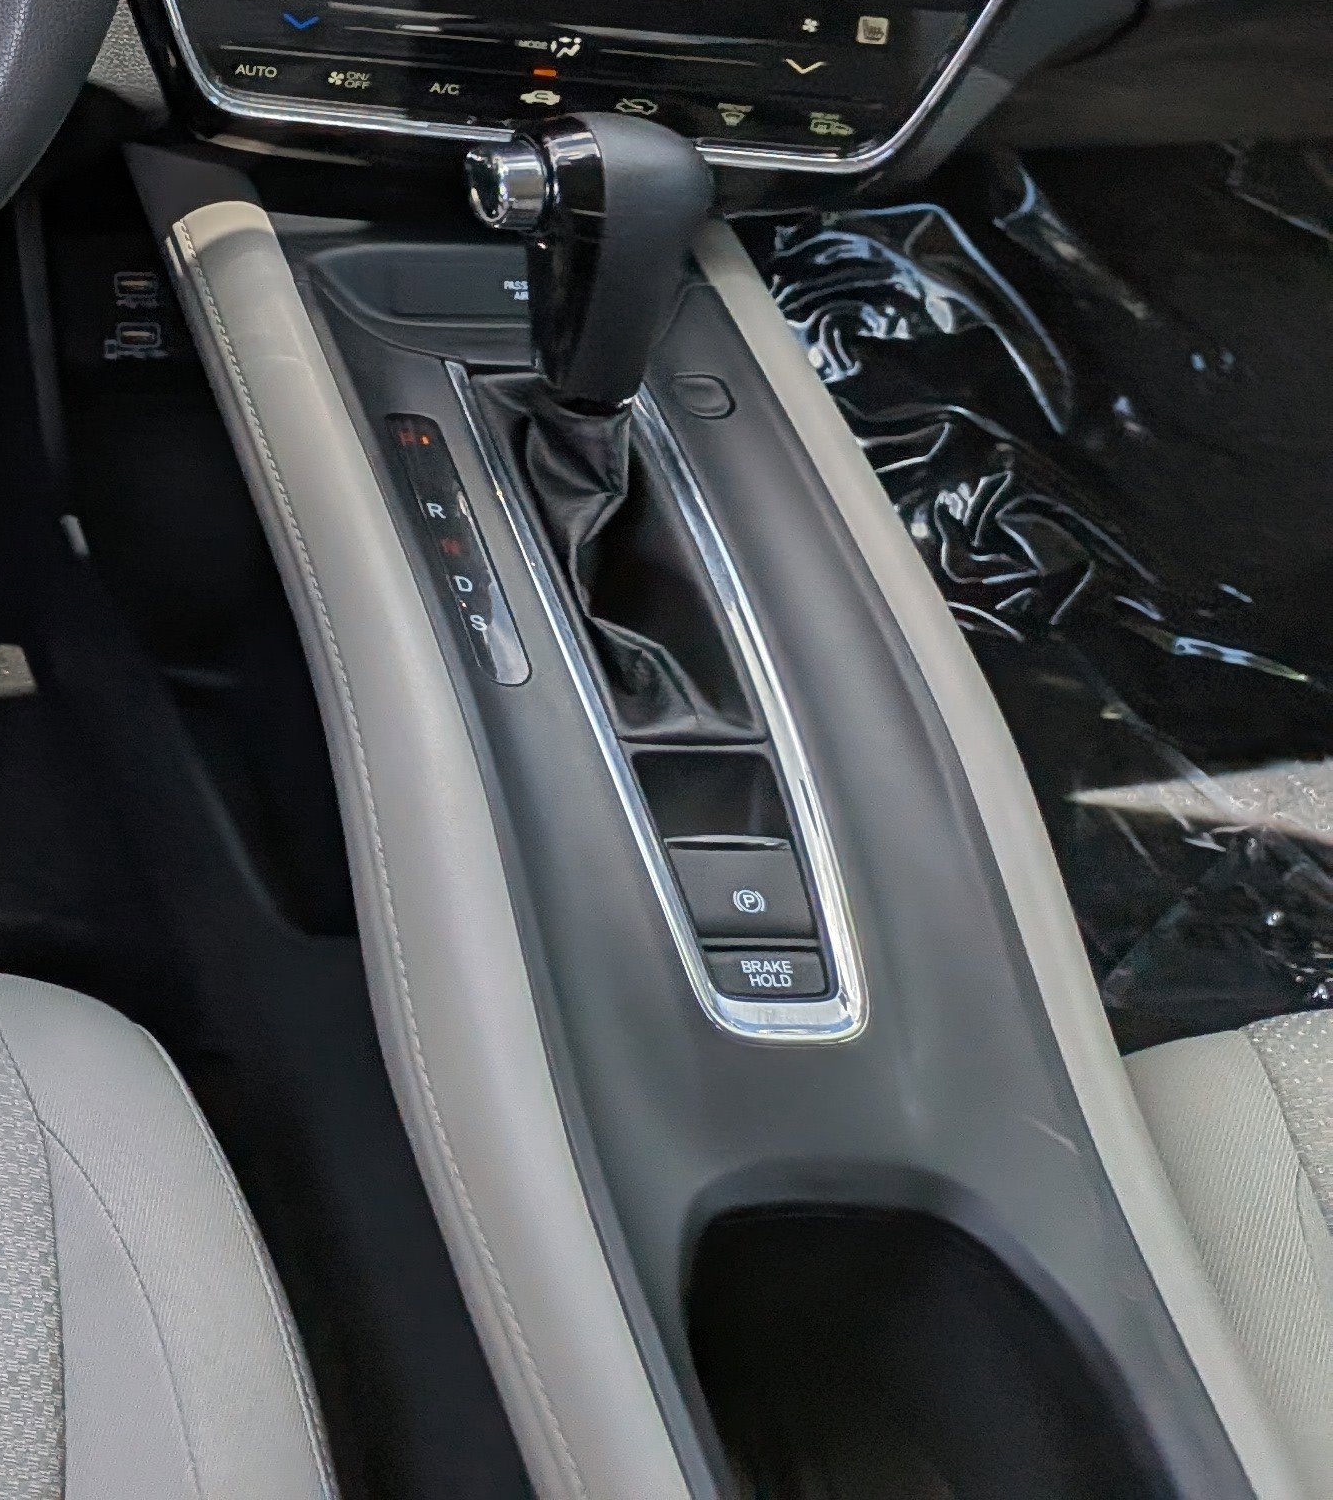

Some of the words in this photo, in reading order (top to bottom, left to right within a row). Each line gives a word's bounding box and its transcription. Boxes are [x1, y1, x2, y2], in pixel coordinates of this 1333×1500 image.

[234, 63, 278, 78] AUTO
[344, 78, 371, 90] OFF
[429, 82, 461, 96] A/C
[425, 501, 447, 520] R
[452, 575, 474, 593] D
[469, 614, 488, 632] S
[740, 960, 794, 974] BRAKE
[749, 973, 792, 988] HOLD
